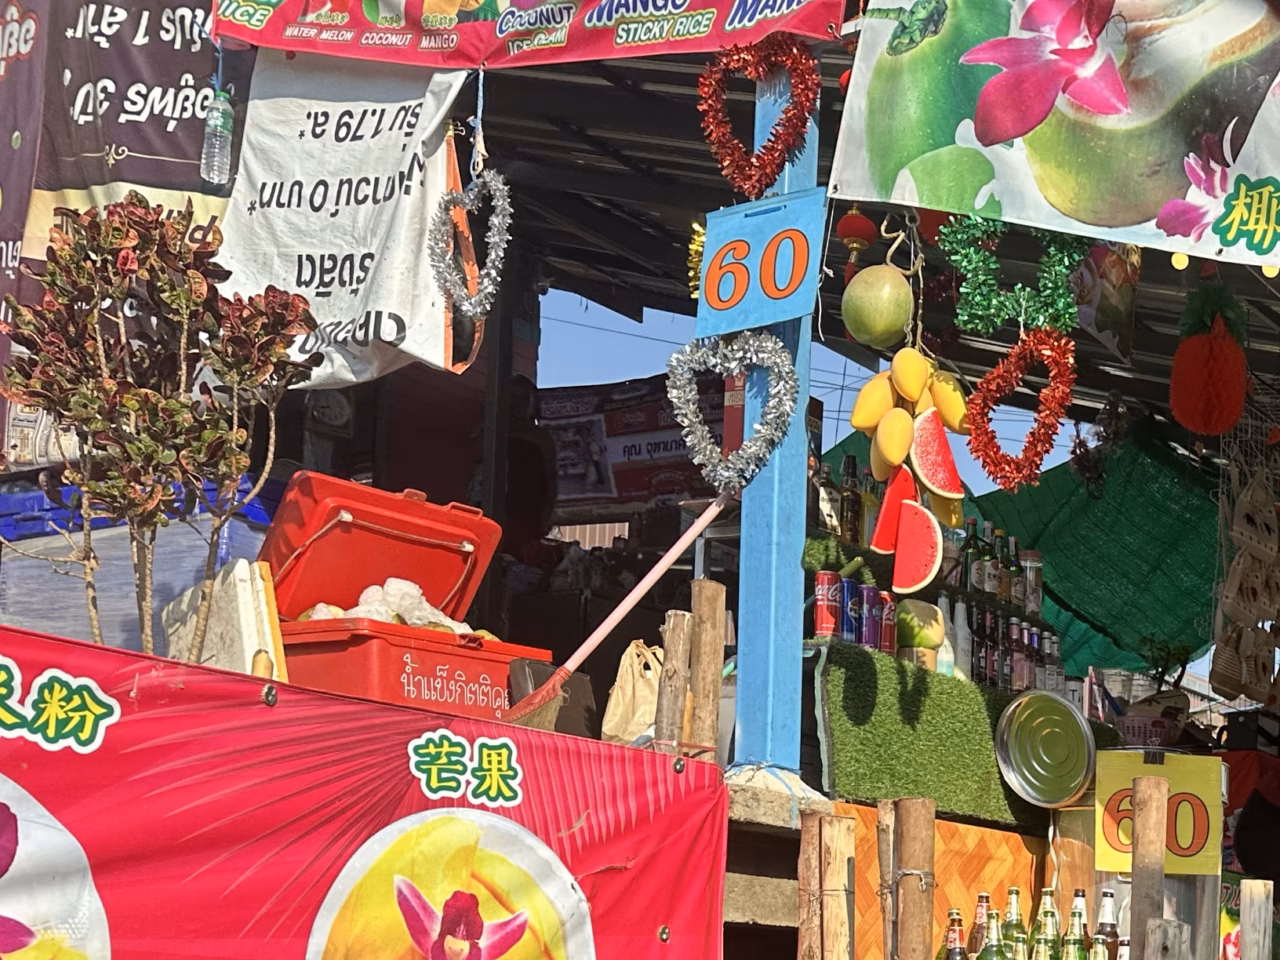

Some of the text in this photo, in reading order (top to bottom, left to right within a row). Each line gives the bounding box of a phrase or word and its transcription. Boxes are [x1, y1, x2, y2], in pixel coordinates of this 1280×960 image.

[217, 0, 270, 27] ICE
[496, 5, 576, 38] COCONUT
[614, 13, 715, 45] STICKY RICE
[284, 26, 354, 41] WATER MELON
[361, 32, 412, 46] COCONUT
[420, 34, 457, 49] MANGO
[333, 108, 386, 143] 1.79
[704, 228, 810, 311] 60
[412, 738, 520, 801] 芒果
[1102, 787, 1210, 859] 60
